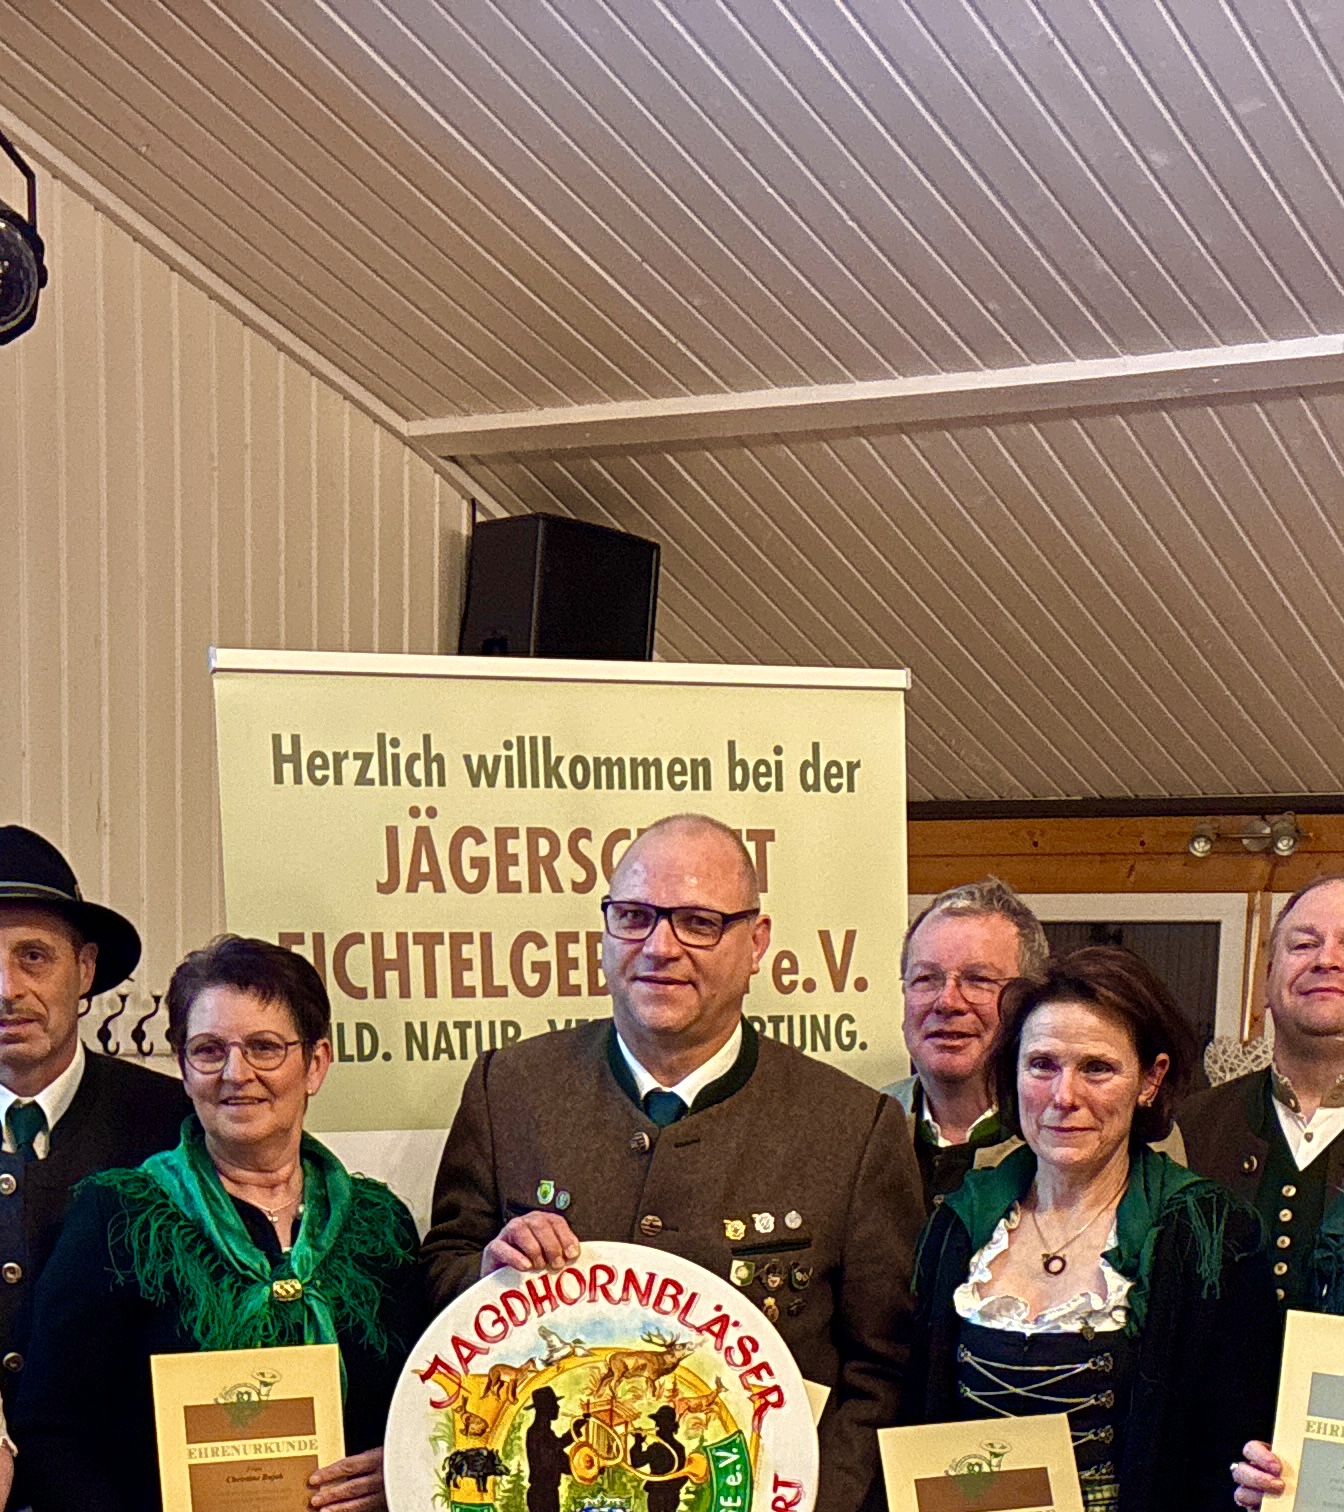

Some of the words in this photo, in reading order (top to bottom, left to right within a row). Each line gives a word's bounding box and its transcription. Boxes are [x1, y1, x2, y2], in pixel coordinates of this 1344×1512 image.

[271, 733, 446, 788] Herzlich
[463, 735, 712, 792] willkommen
[727, 740, 784, 792] bei
[799, 741, 862, 794] der
[771, 929, 869, 996] e.V.
[419, 1263, 787, 1433] JAGDHORNBLÄSER
[187, 1438, 319, 1460] EHRENURKUNDE
